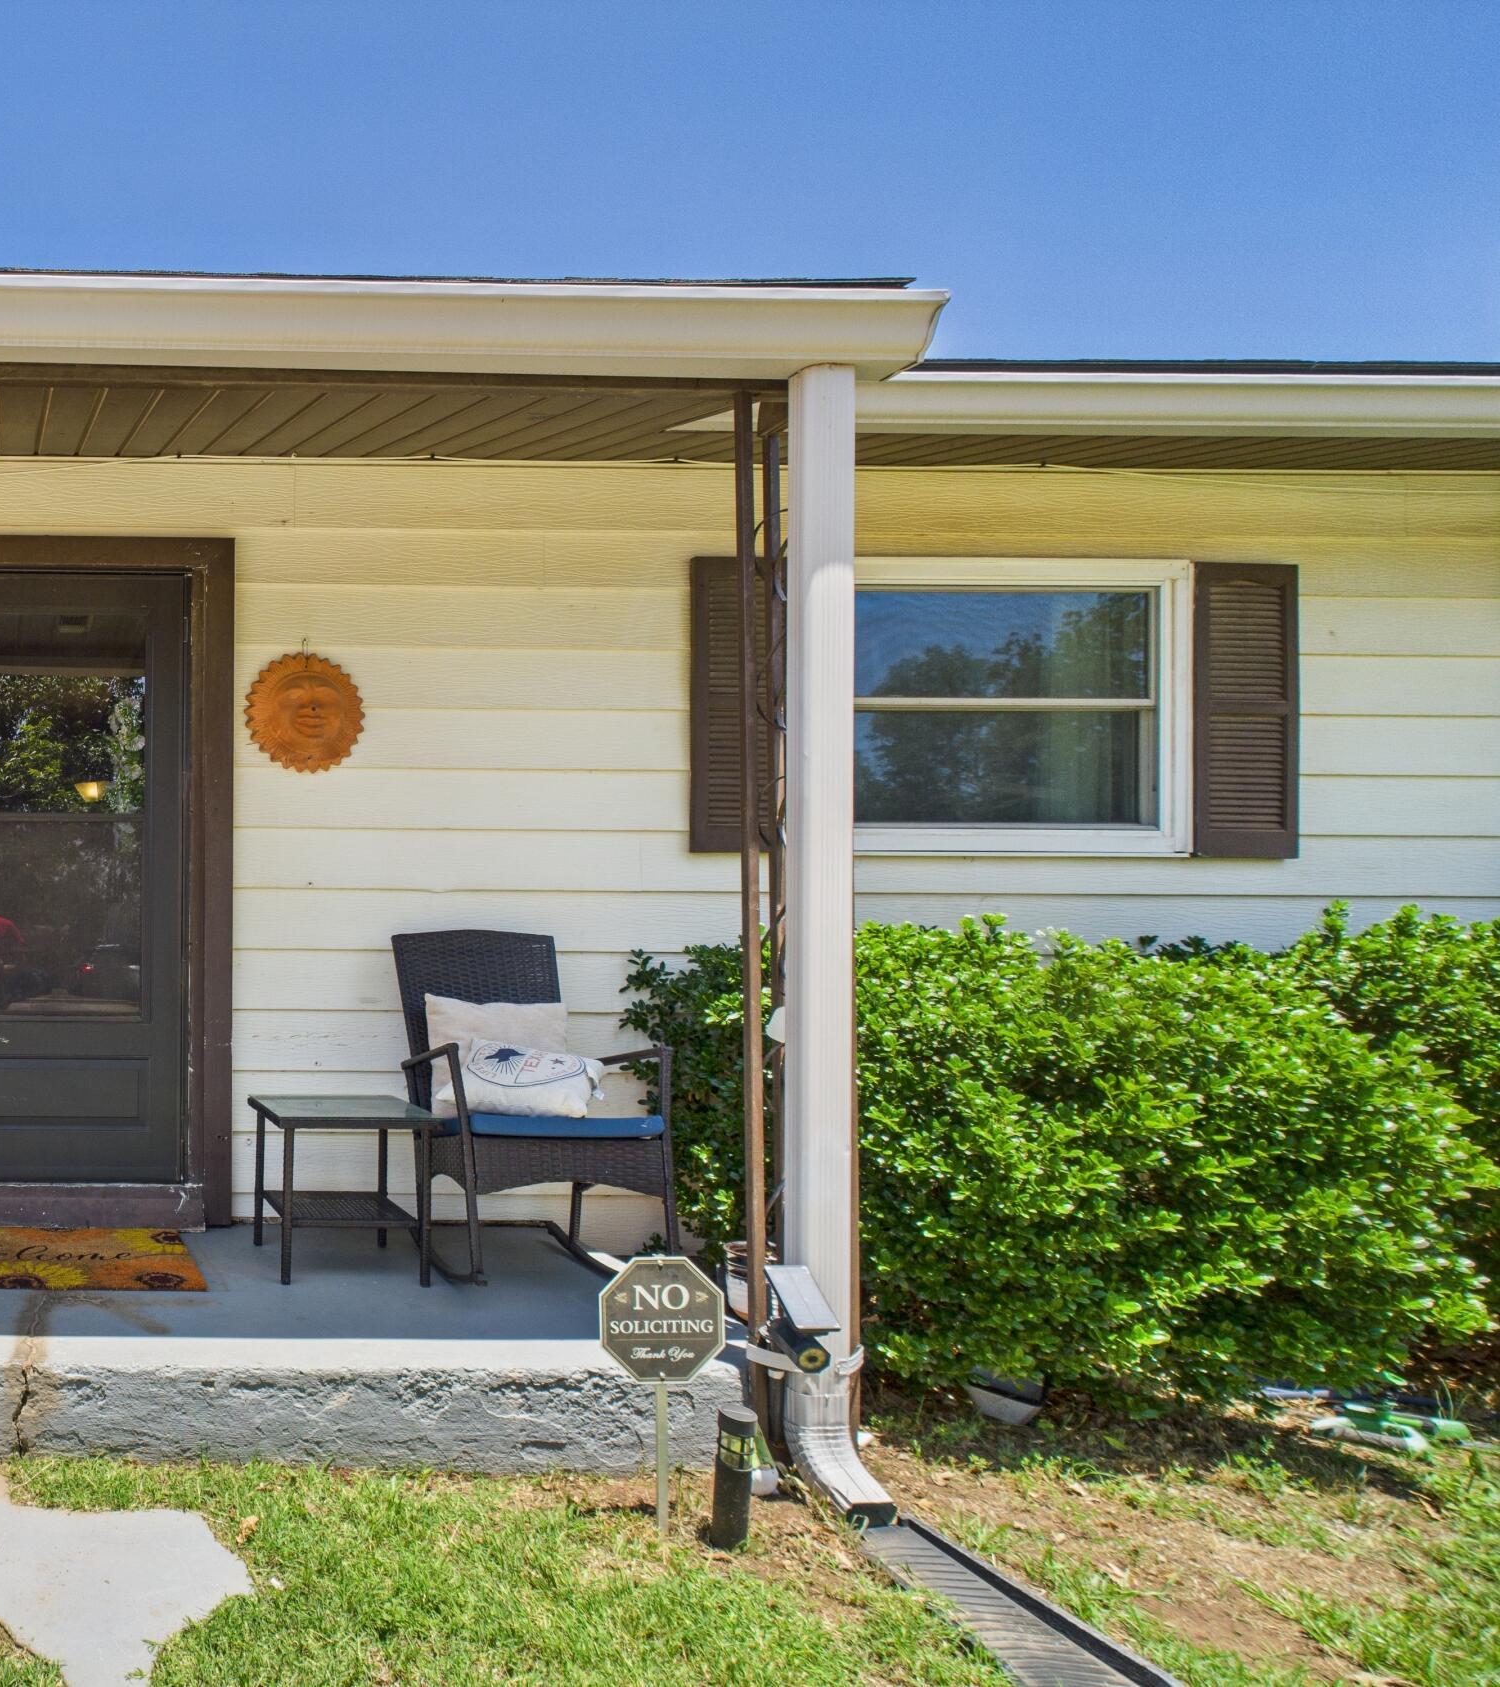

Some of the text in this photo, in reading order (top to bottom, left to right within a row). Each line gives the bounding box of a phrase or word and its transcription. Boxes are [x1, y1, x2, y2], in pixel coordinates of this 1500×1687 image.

[632, 1283, 691, 1311] NO
[609, 1319, 714, 1335] SOLICITING
[630, 1345, 696, 1362] Thank You
